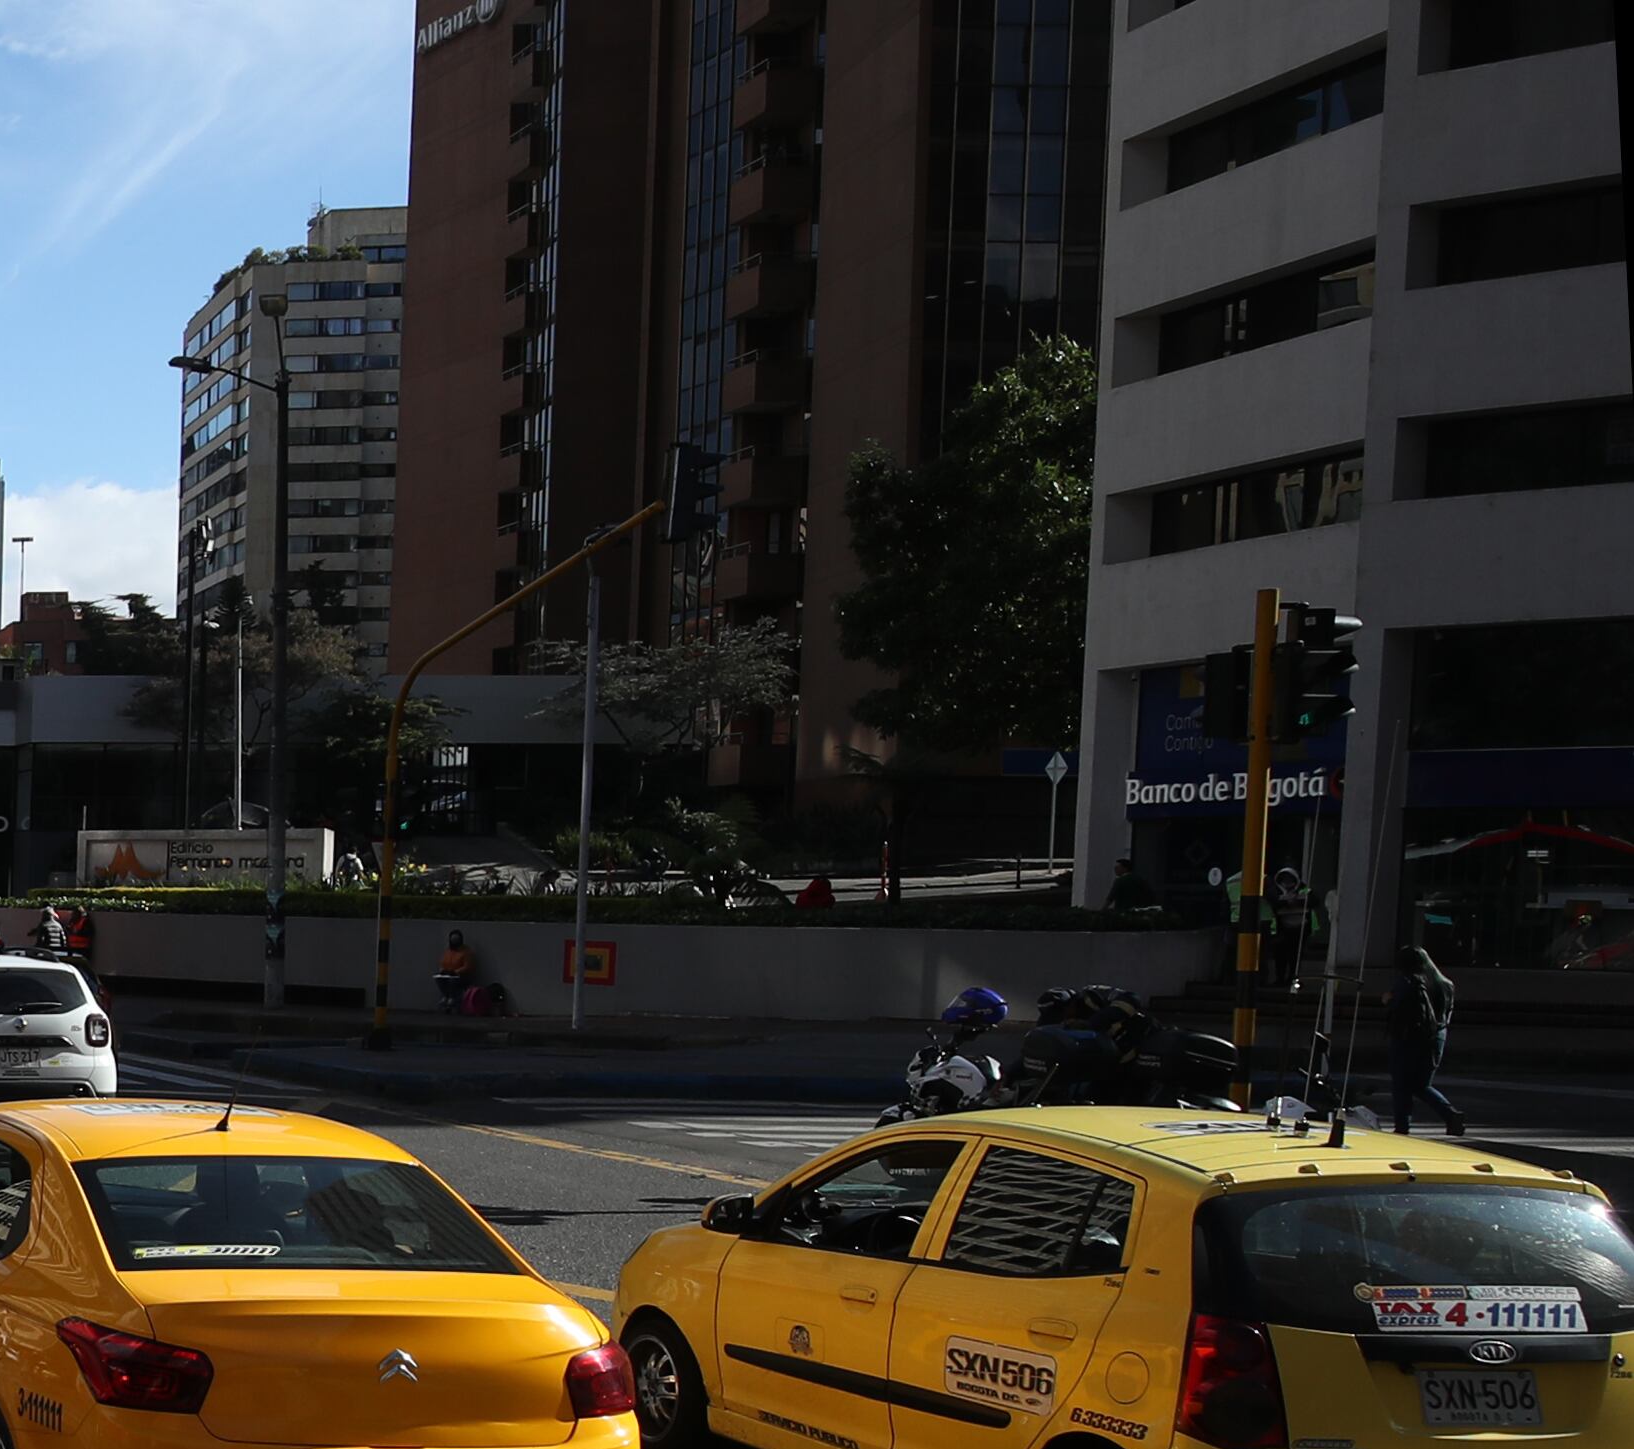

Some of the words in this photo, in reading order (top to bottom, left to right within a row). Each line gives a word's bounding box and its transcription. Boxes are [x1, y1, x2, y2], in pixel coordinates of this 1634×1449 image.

[416, 3, 475, 50] Allianz
[1164, 735, 1214, 755] Contigo
[1125, 777, 1196, 806] Banco
[1198, 773, 1232, 802] de
[1232, 767, 1328, 807] Bgotá
[238, 857, 305, 870] mazra
[0, 1051, 20, 1063] JTS
[21, 1050, 40, 1063] 217
[1377, 1315, 1440, 1327] express
[1477, 1344, 1510, 1360] KIA
[946, 1348, 1001, 1384] SXN
[1001, 1361, 1055, 1396] 506
[956, 1381, 1000, 1401] BOGOTA
[1424, 1380, 1476, 1411] SXN
[1482, 1379, 1536, 1411] 506
